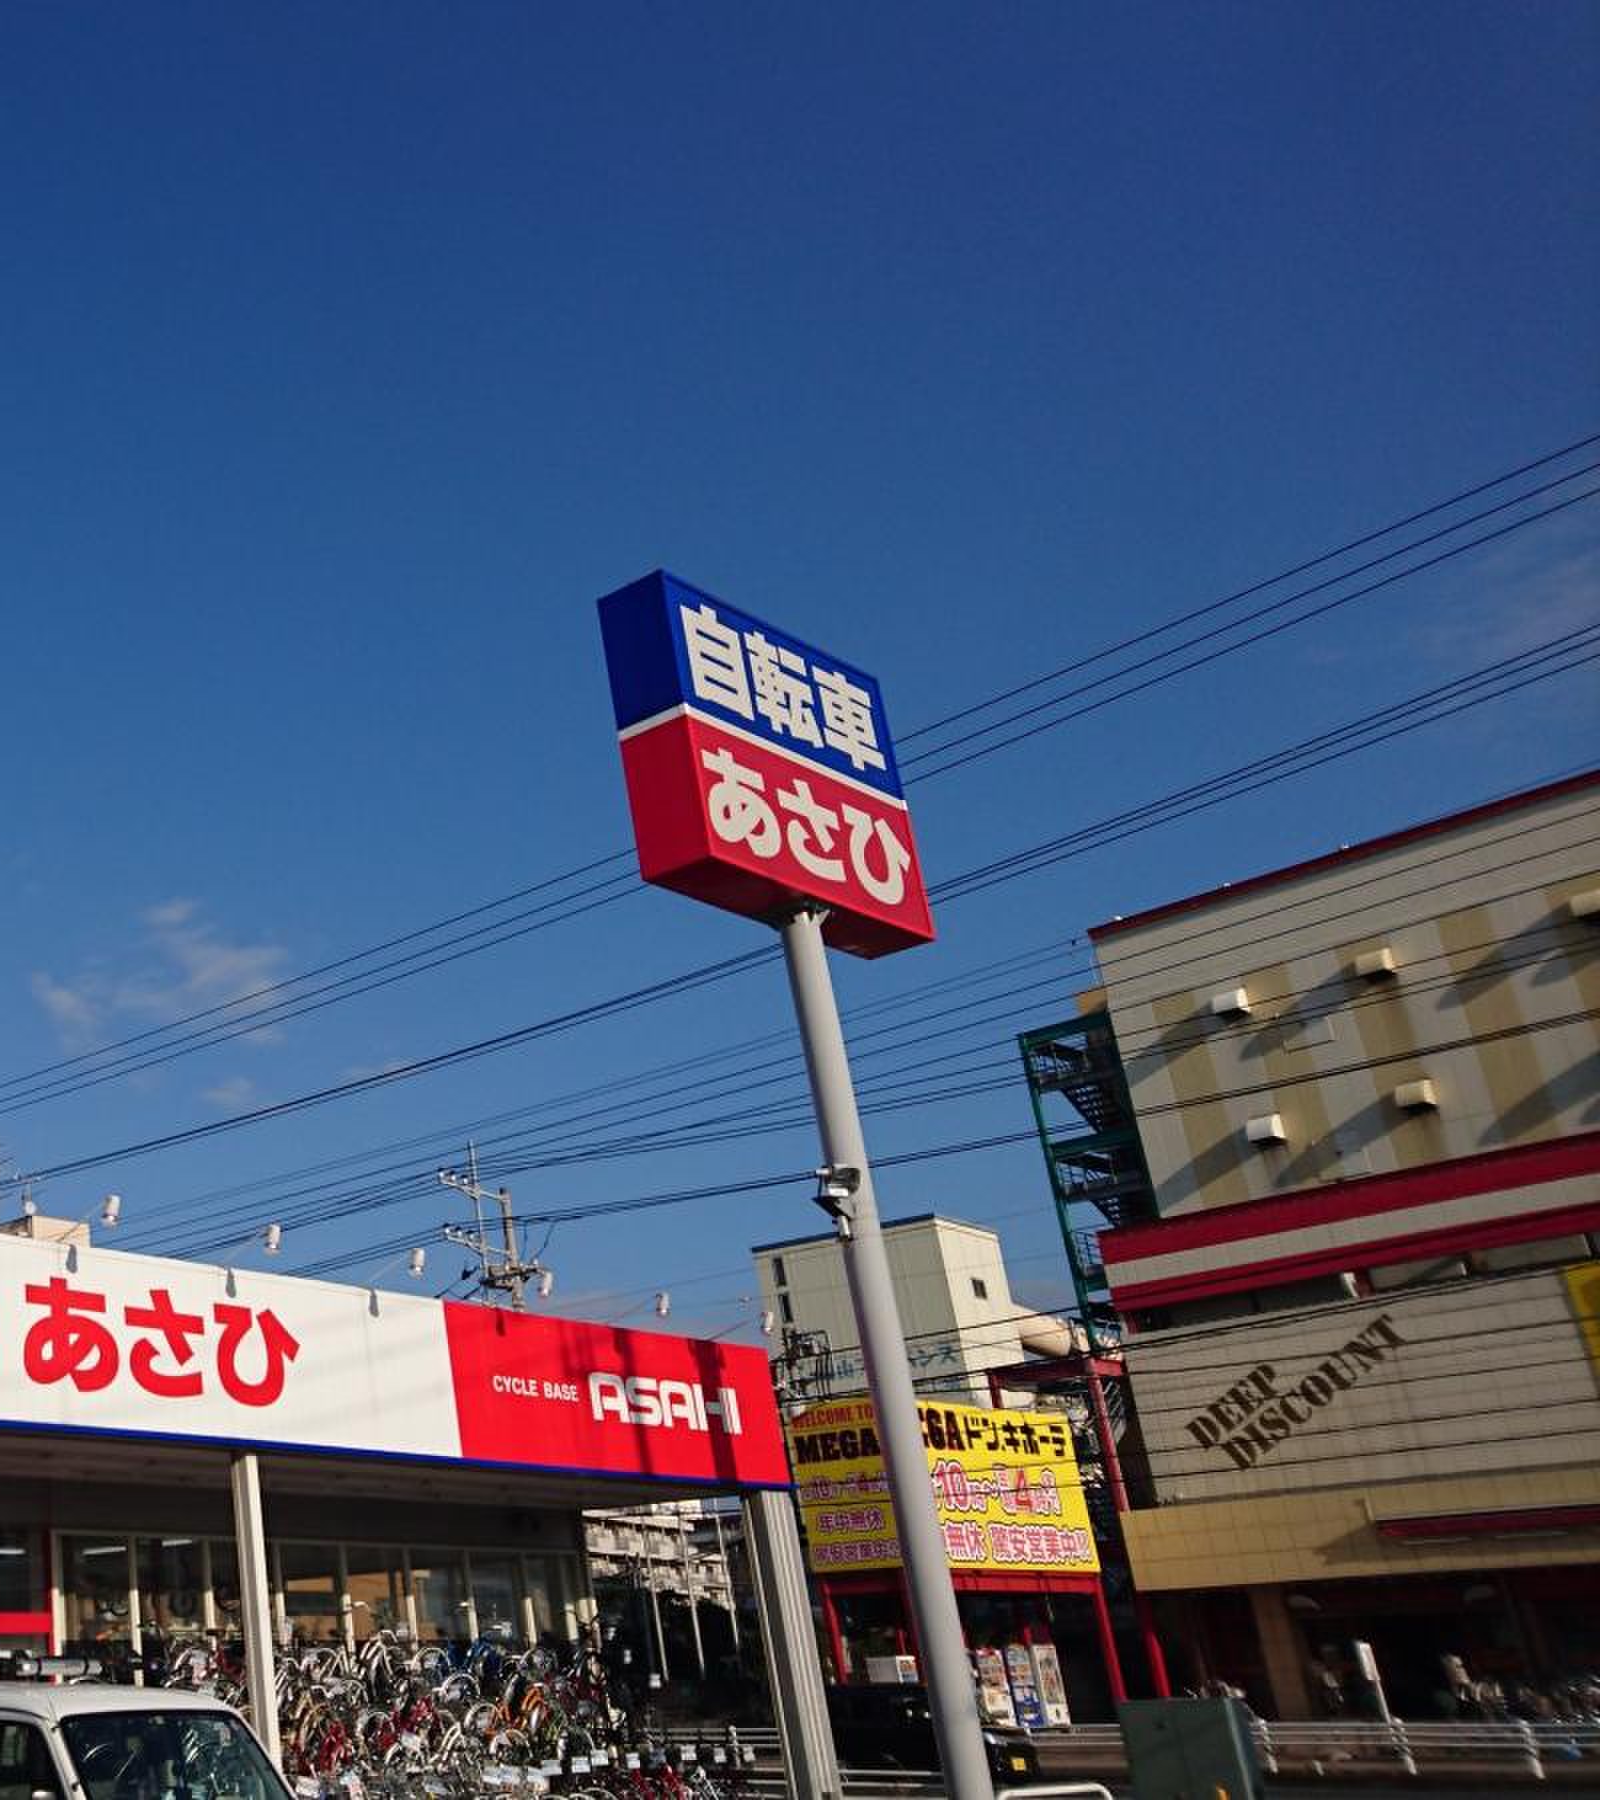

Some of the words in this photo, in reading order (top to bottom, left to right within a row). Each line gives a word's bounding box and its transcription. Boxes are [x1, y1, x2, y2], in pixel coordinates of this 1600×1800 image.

[680, 604, 887, 771] 自転車
[701, 747, 911, 905] あさひ
[23, 1276, 301, 1408] あさひ
[492, 1375, 539, 1398] CYCLE
[542, 1380, 579, 1402] BASE
[588, 1372, 743, 1435] ASAHI
[1185, 1364, 1278, 1450] DEEP
[1221, 1313, 1406, 1470] DISCOUNT
[794, 1428, 881, 1464] MEGA
